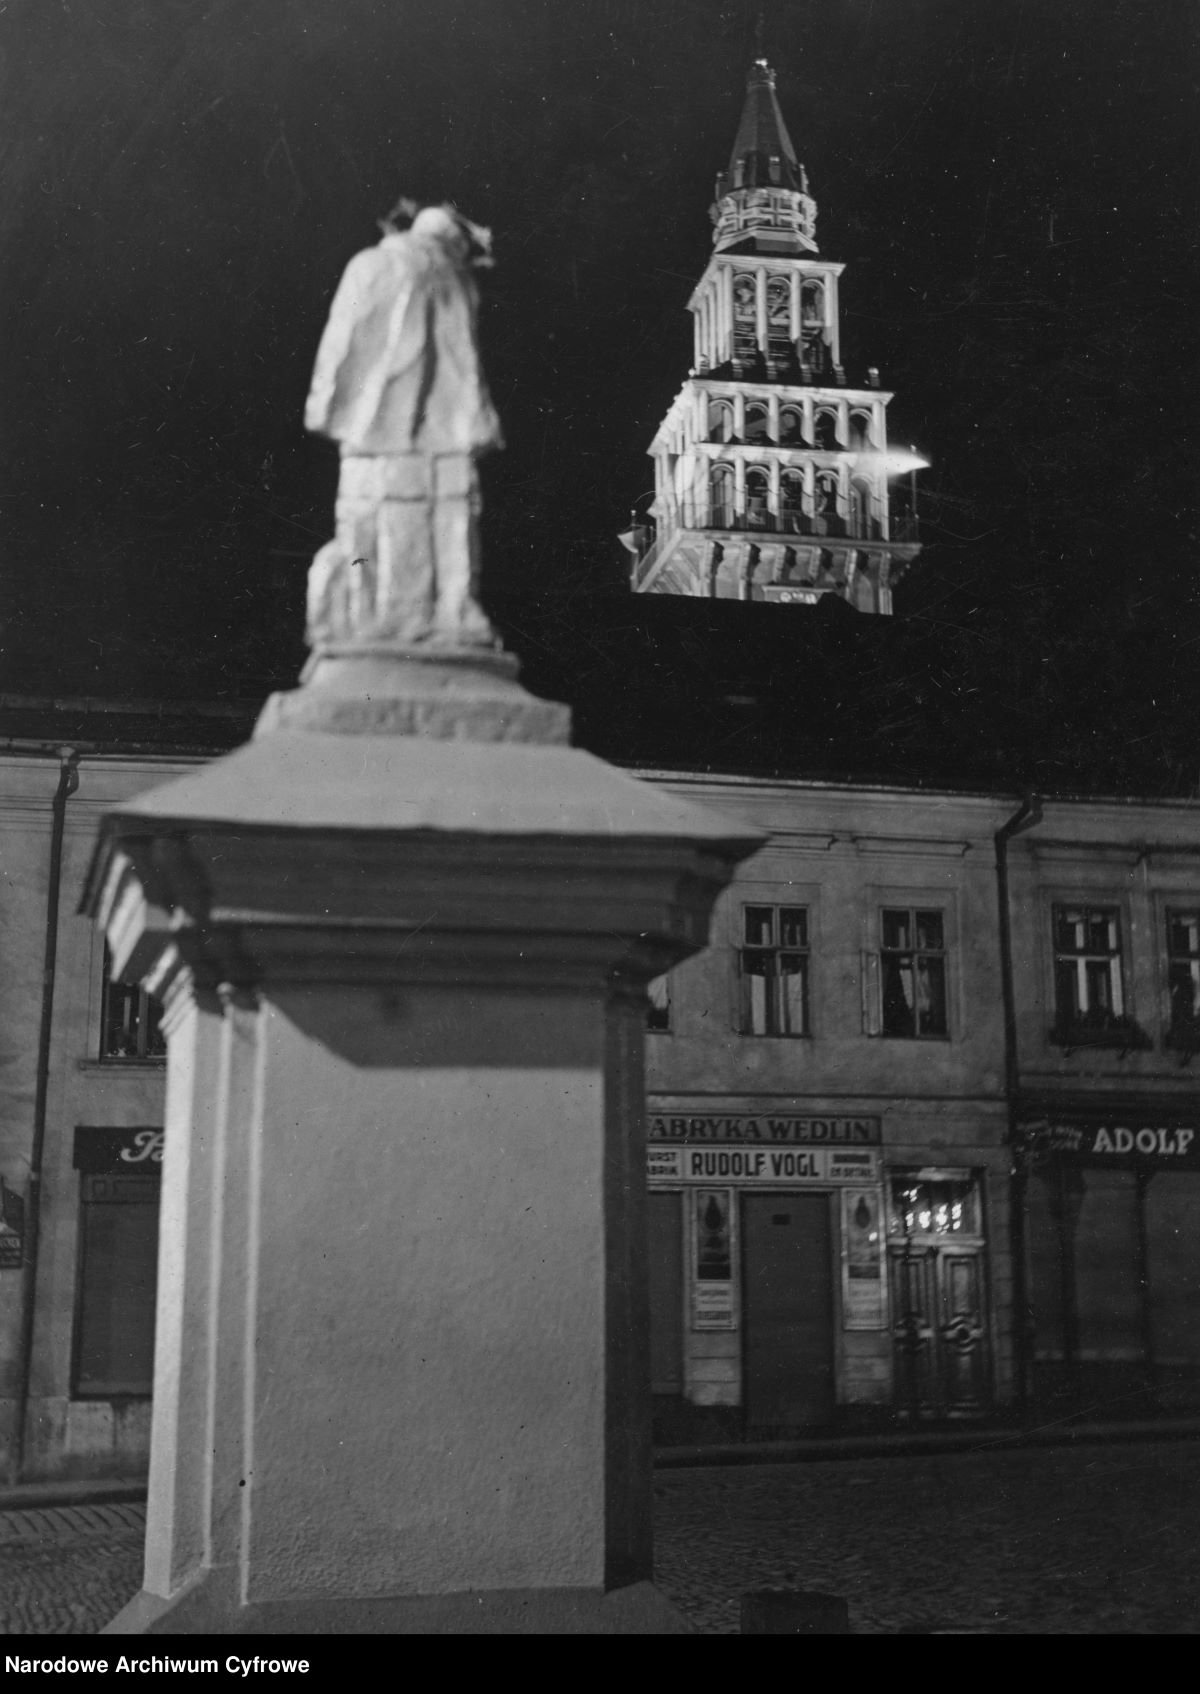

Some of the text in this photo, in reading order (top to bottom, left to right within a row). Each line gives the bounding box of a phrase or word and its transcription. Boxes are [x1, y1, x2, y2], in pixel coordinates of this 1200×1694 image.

[647, 1118, 870, 1140] ABRYKA WEDLIN
[1092, 1127, 1195, 1155] ADOLF
[646, 1151, 677, 1162] URST
[691, 1152, 820, 1178] RUDOLF VOGL
